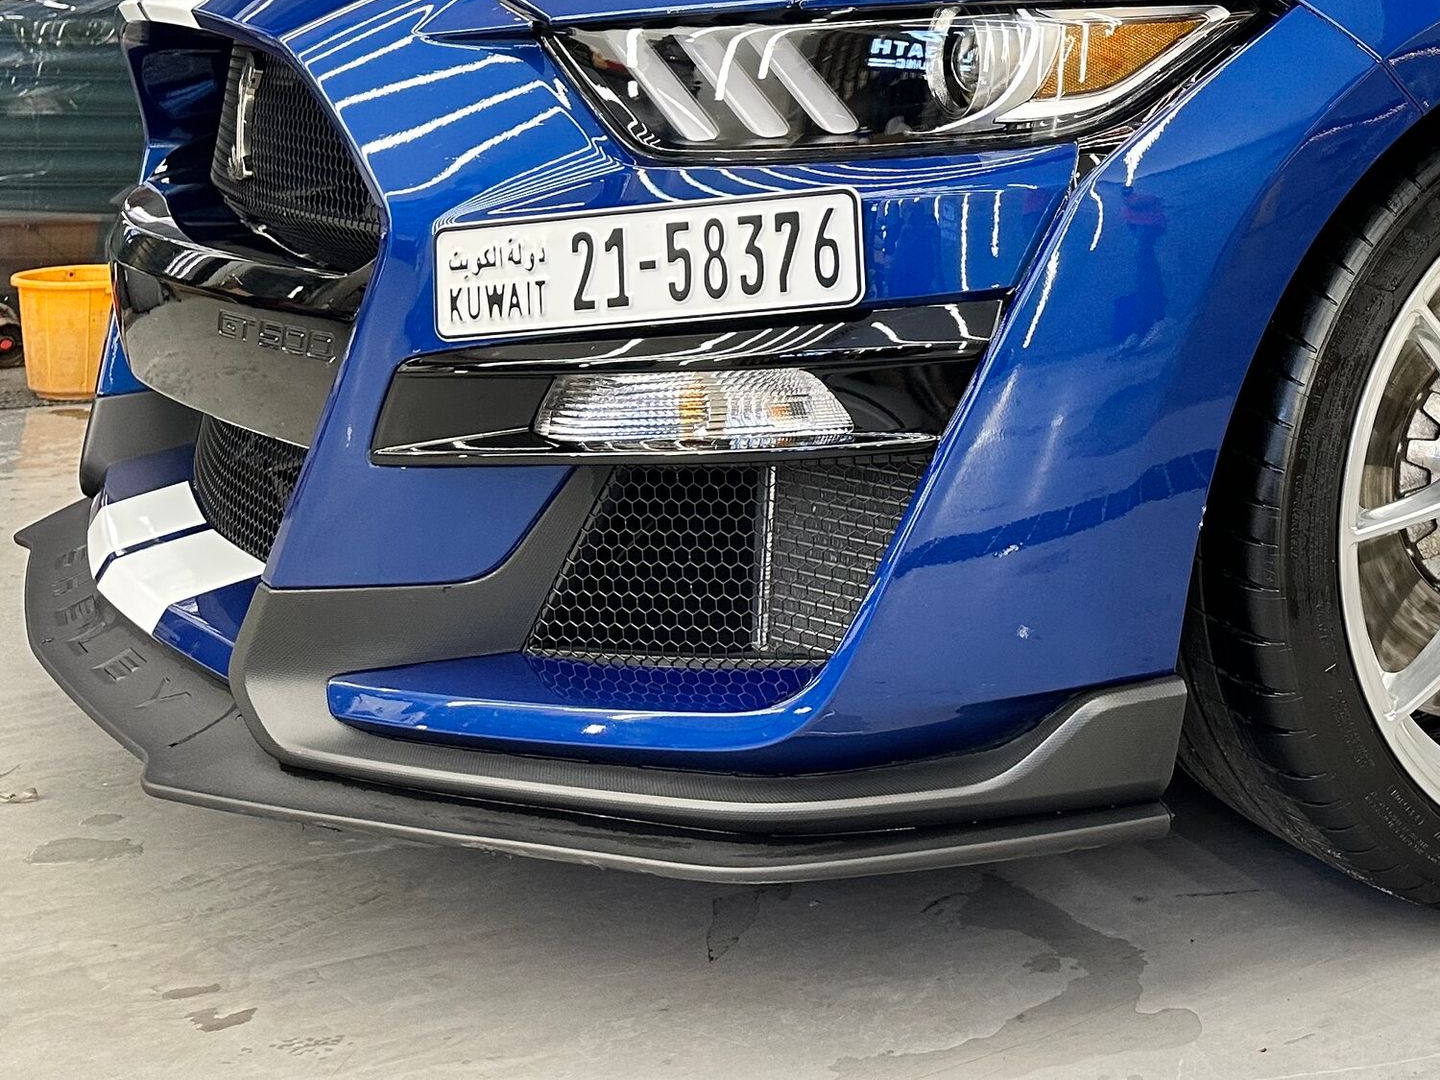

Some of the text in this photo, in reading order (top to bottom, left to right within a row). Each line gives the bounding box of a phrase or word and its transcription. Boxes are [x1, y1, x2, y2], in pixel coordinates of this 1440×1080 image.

[449, 238, 546, 280] دولة الكويت
[571, 207, 841, 311] 21-58376
[449, 280, 546, 323] KUWAIT
